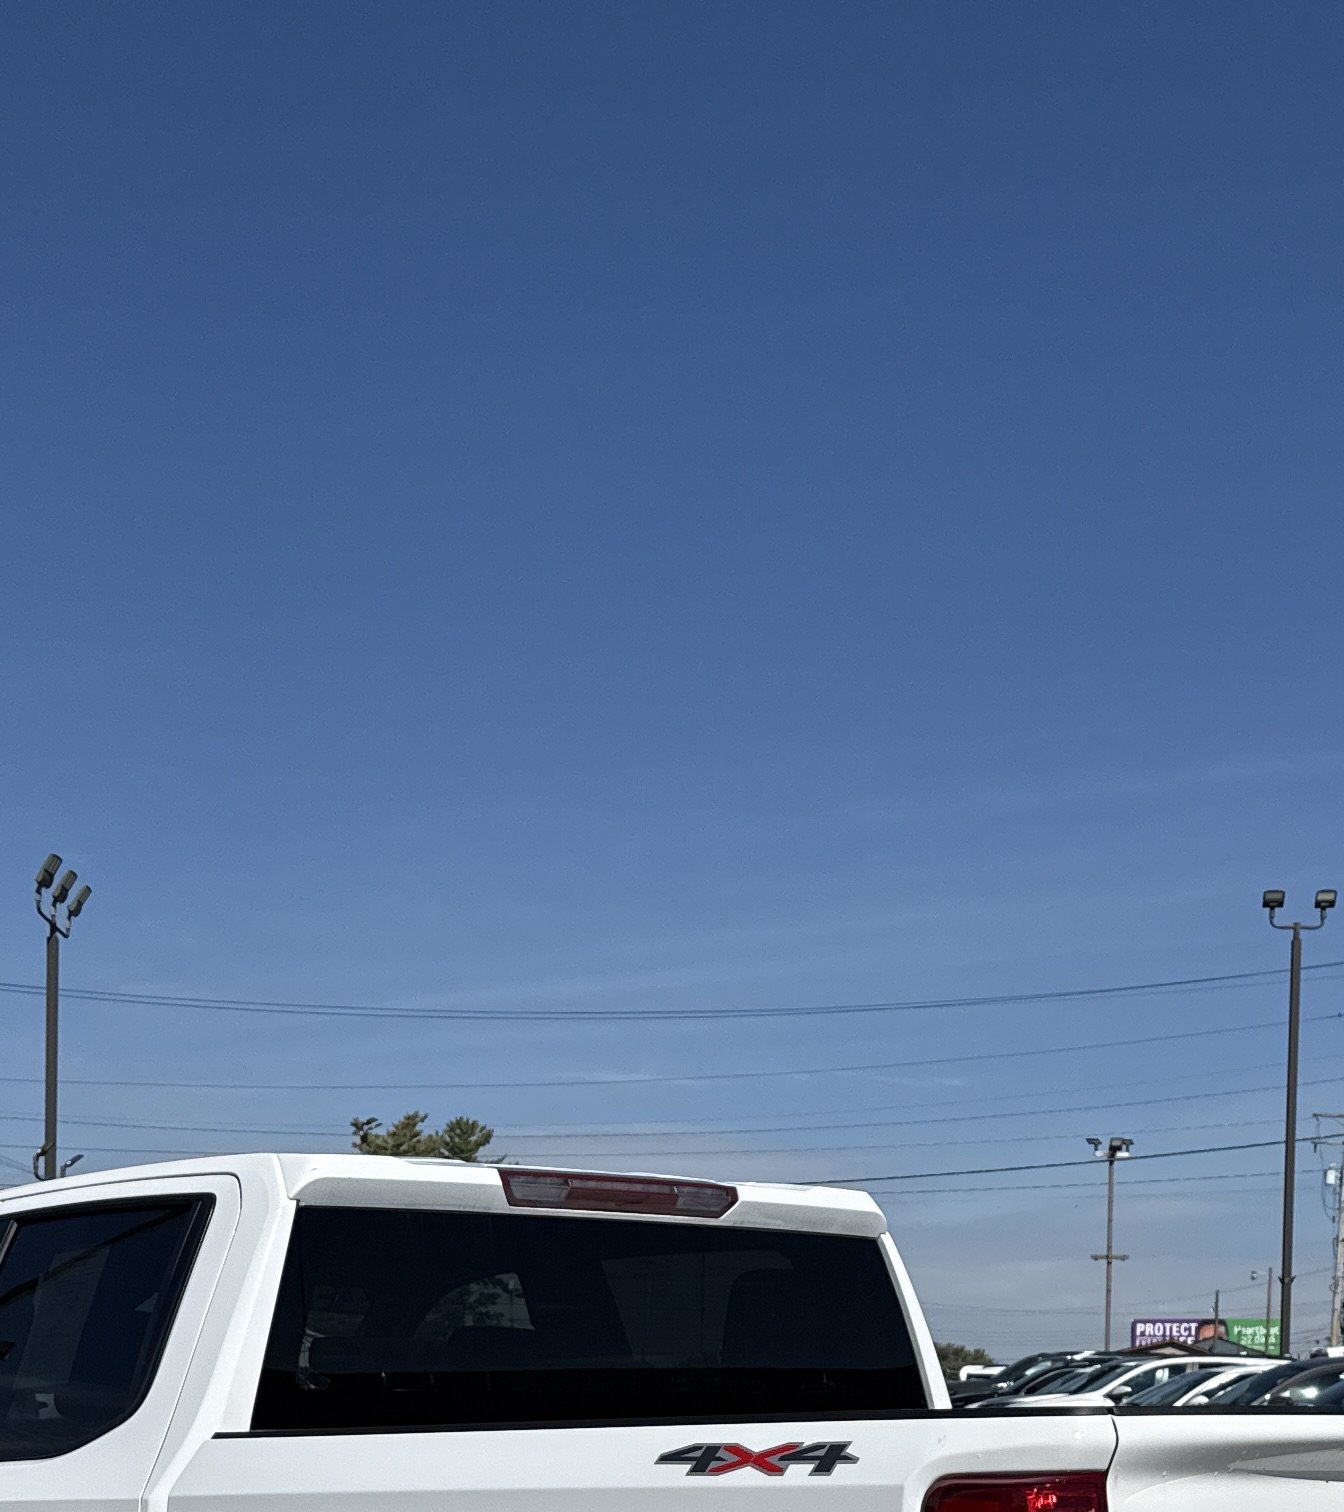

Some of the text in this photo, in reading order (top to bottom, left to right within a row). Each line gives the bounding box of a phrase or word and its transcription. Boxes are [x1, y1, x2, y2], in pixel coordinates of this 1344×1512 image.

[1136, 1322, 1198, 1337] PROTECT
[1233, 1324, 1280, 1336] Heartbat
[1254, 1334, 1276, 1345] das
[654, 1440, 860, 1477] 4X4
